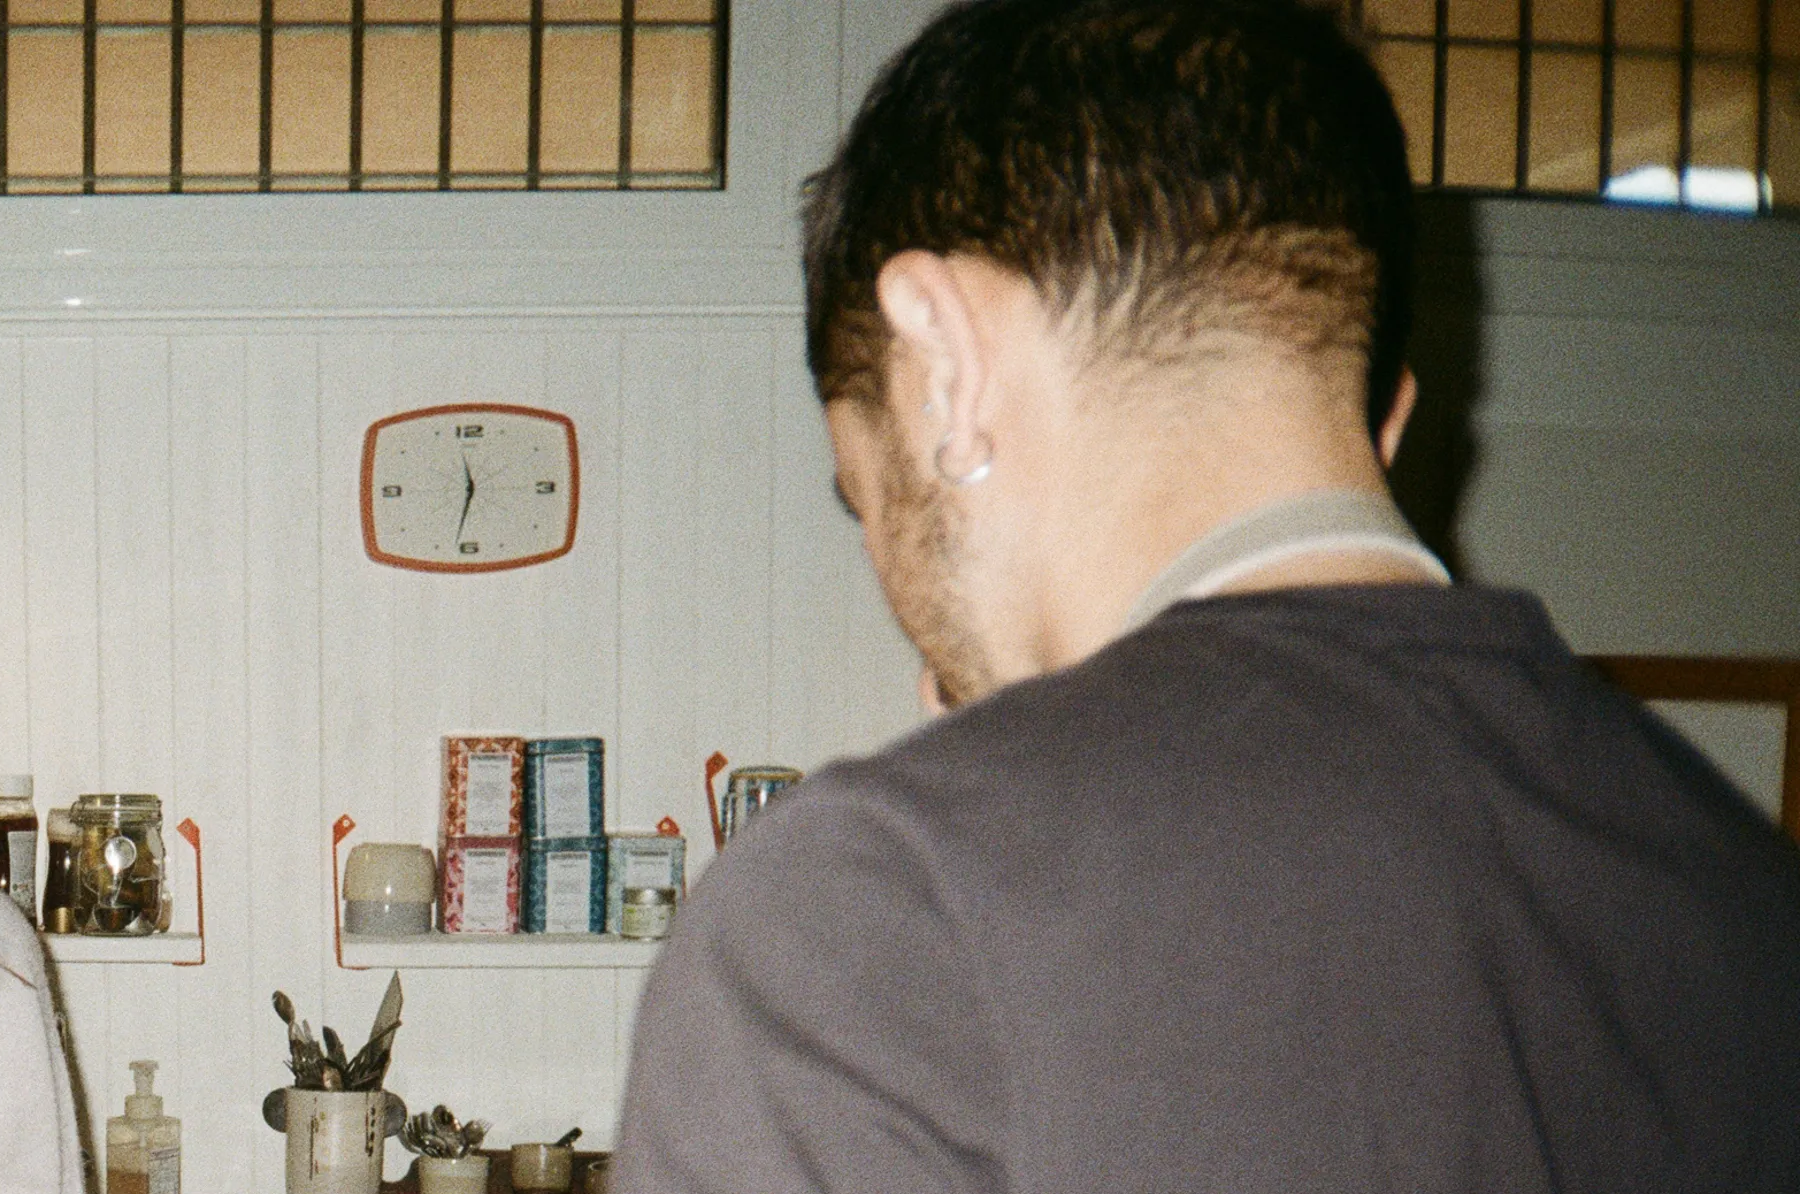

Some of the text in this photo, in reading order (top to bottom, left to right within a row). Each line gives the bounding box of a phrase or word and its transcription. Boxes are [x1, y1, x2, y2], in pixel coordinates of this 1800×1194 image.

[455, 424, 485, 438] 12
[382, 484, 402, 498] 9
[535, 481, 556, 495] 3
[459, 541, 480, 555] 6
